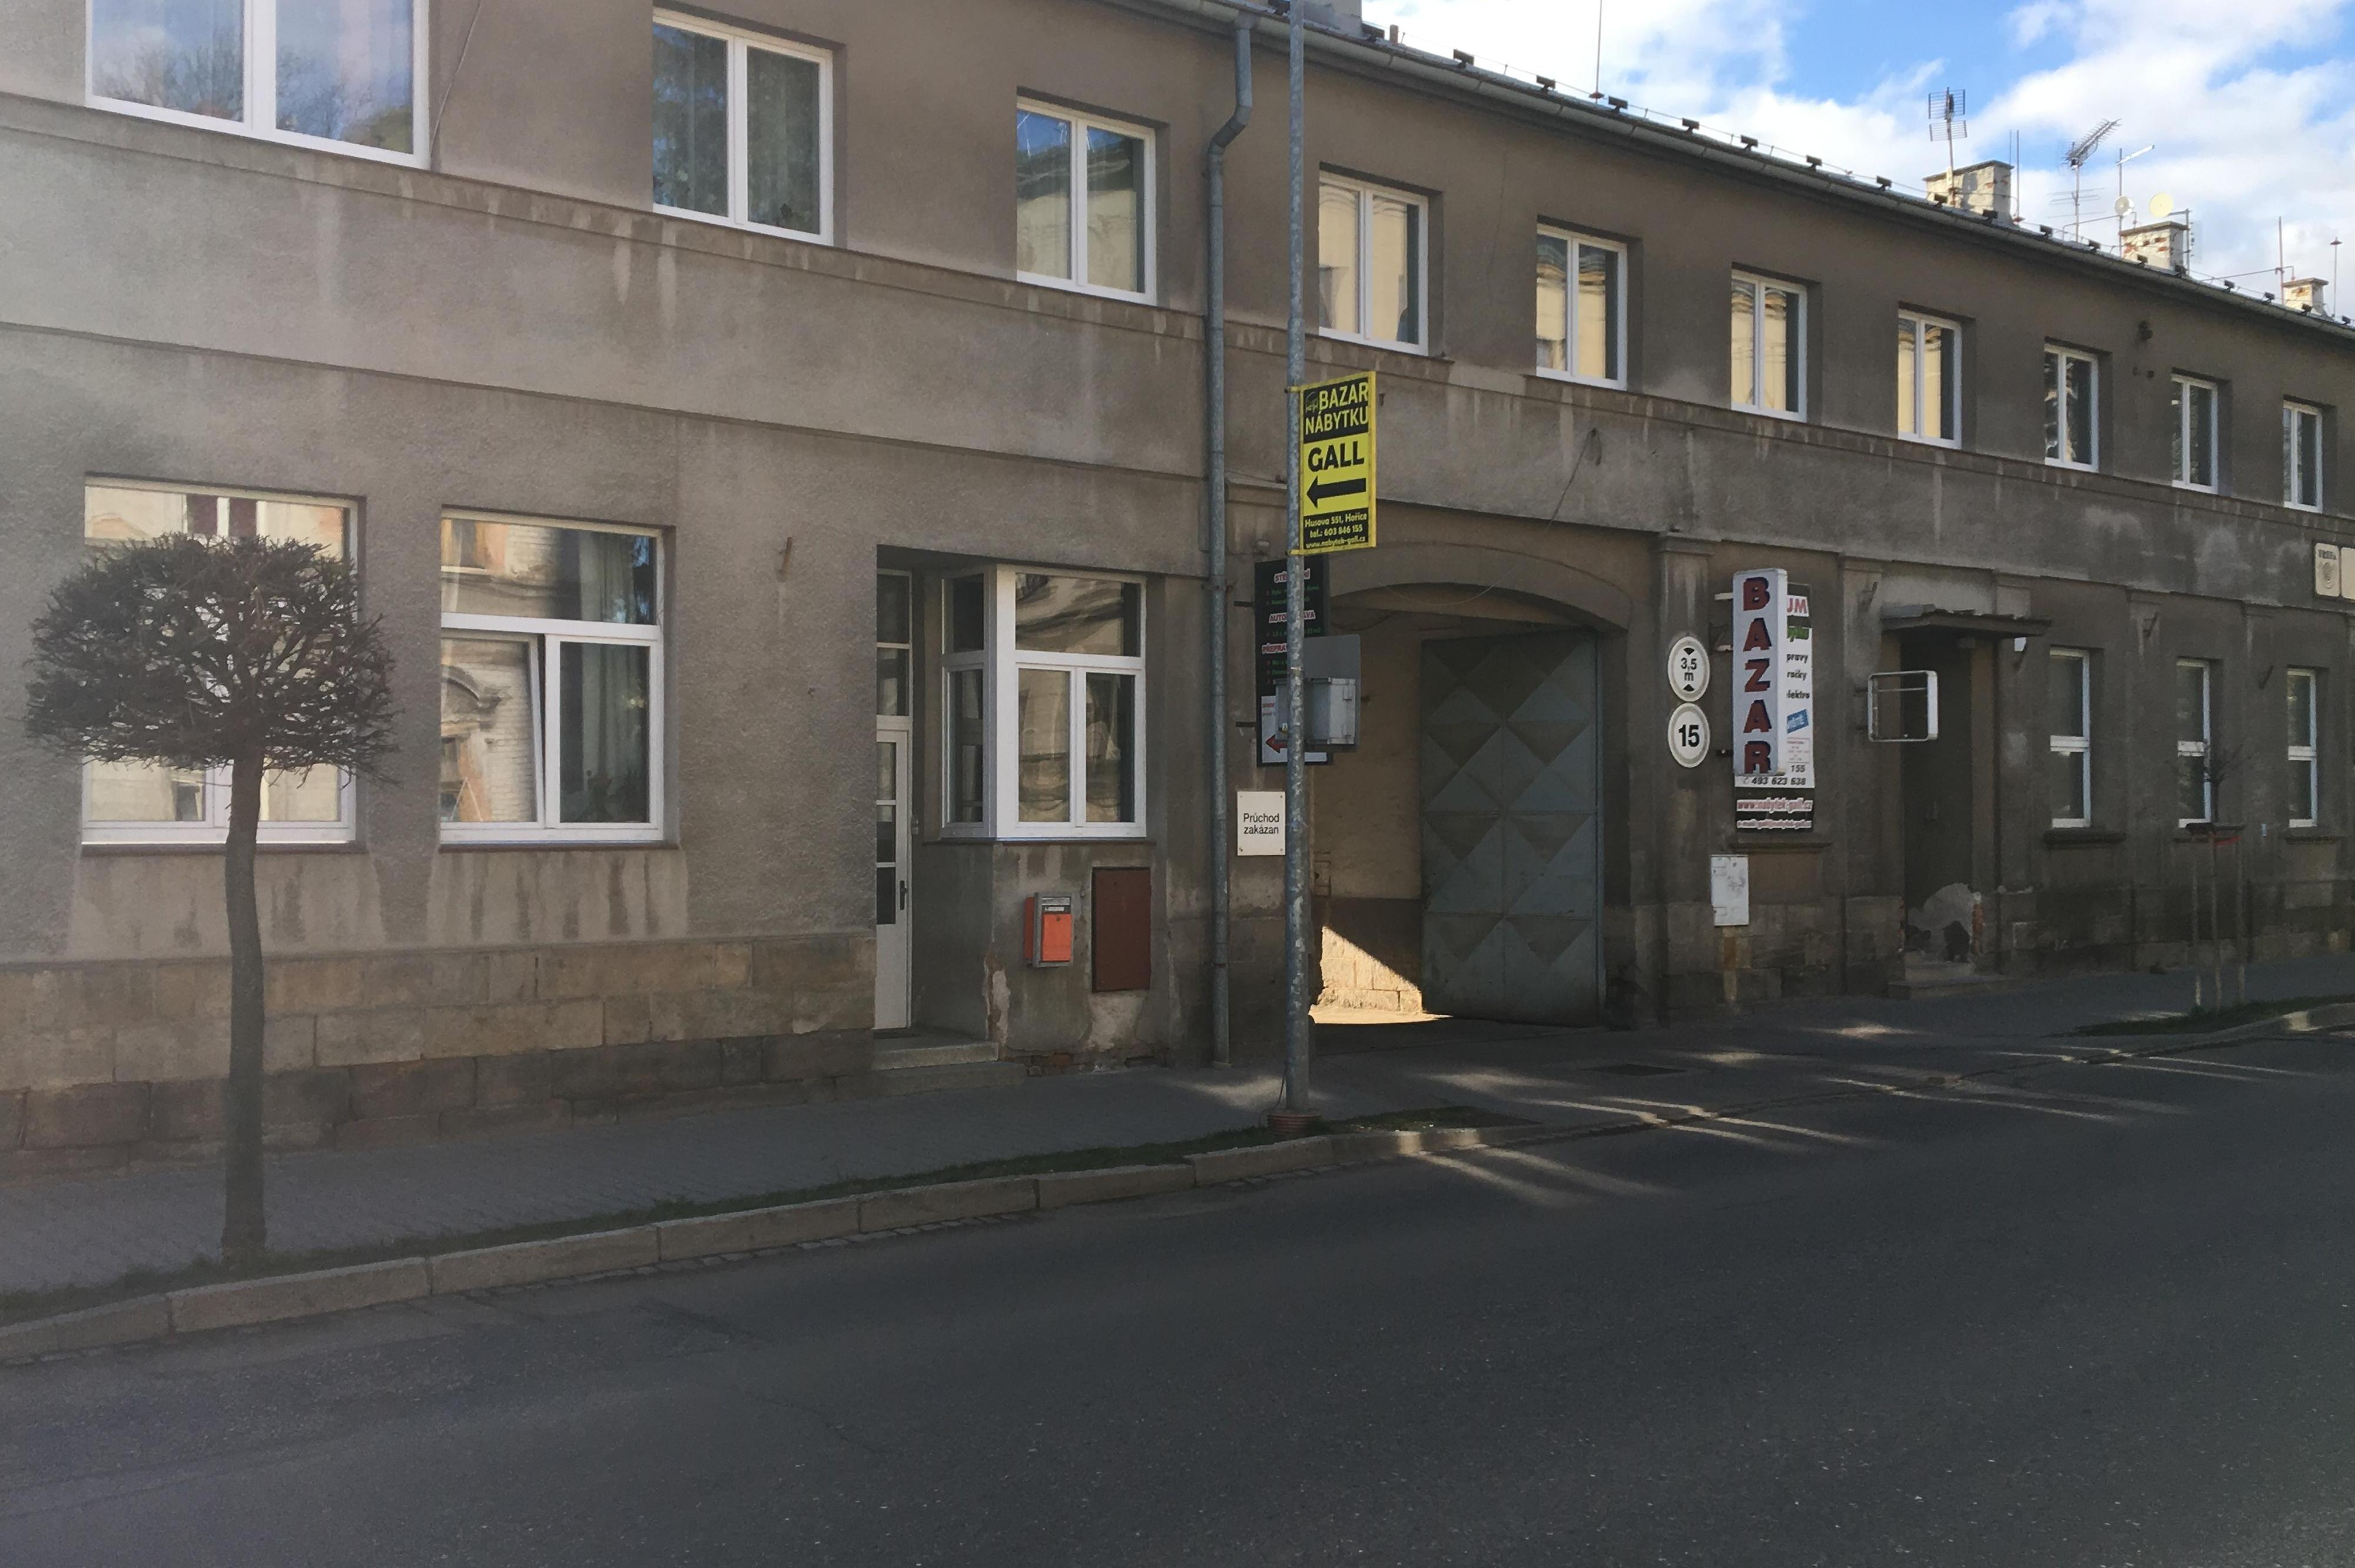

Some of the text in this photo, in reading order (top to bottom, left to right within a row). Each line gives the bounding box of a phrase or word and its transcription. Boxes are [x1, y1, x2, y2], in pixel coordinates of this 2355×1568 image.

[1319, 382, 1368, 410] BAZAR
[1305, 406, 1368, 435] NÁBYTKU
[1308, 441, 1365, 472] GALL
[1305, 519, 1329, 527] Husova
[1345, 512, 1367, 523] Hořice
[1324, 527, 1337, 536] 603
[1338, 526, 1351, 534] 846
[1681, 657, 1697, 672] 3,5
[1684, 672, 1694, 681] m
[1743, 576, 1772, 774] BAZAR
[1679, 725, 1700, 748] 15
[1243, 825, 1279, 834] zakázan
